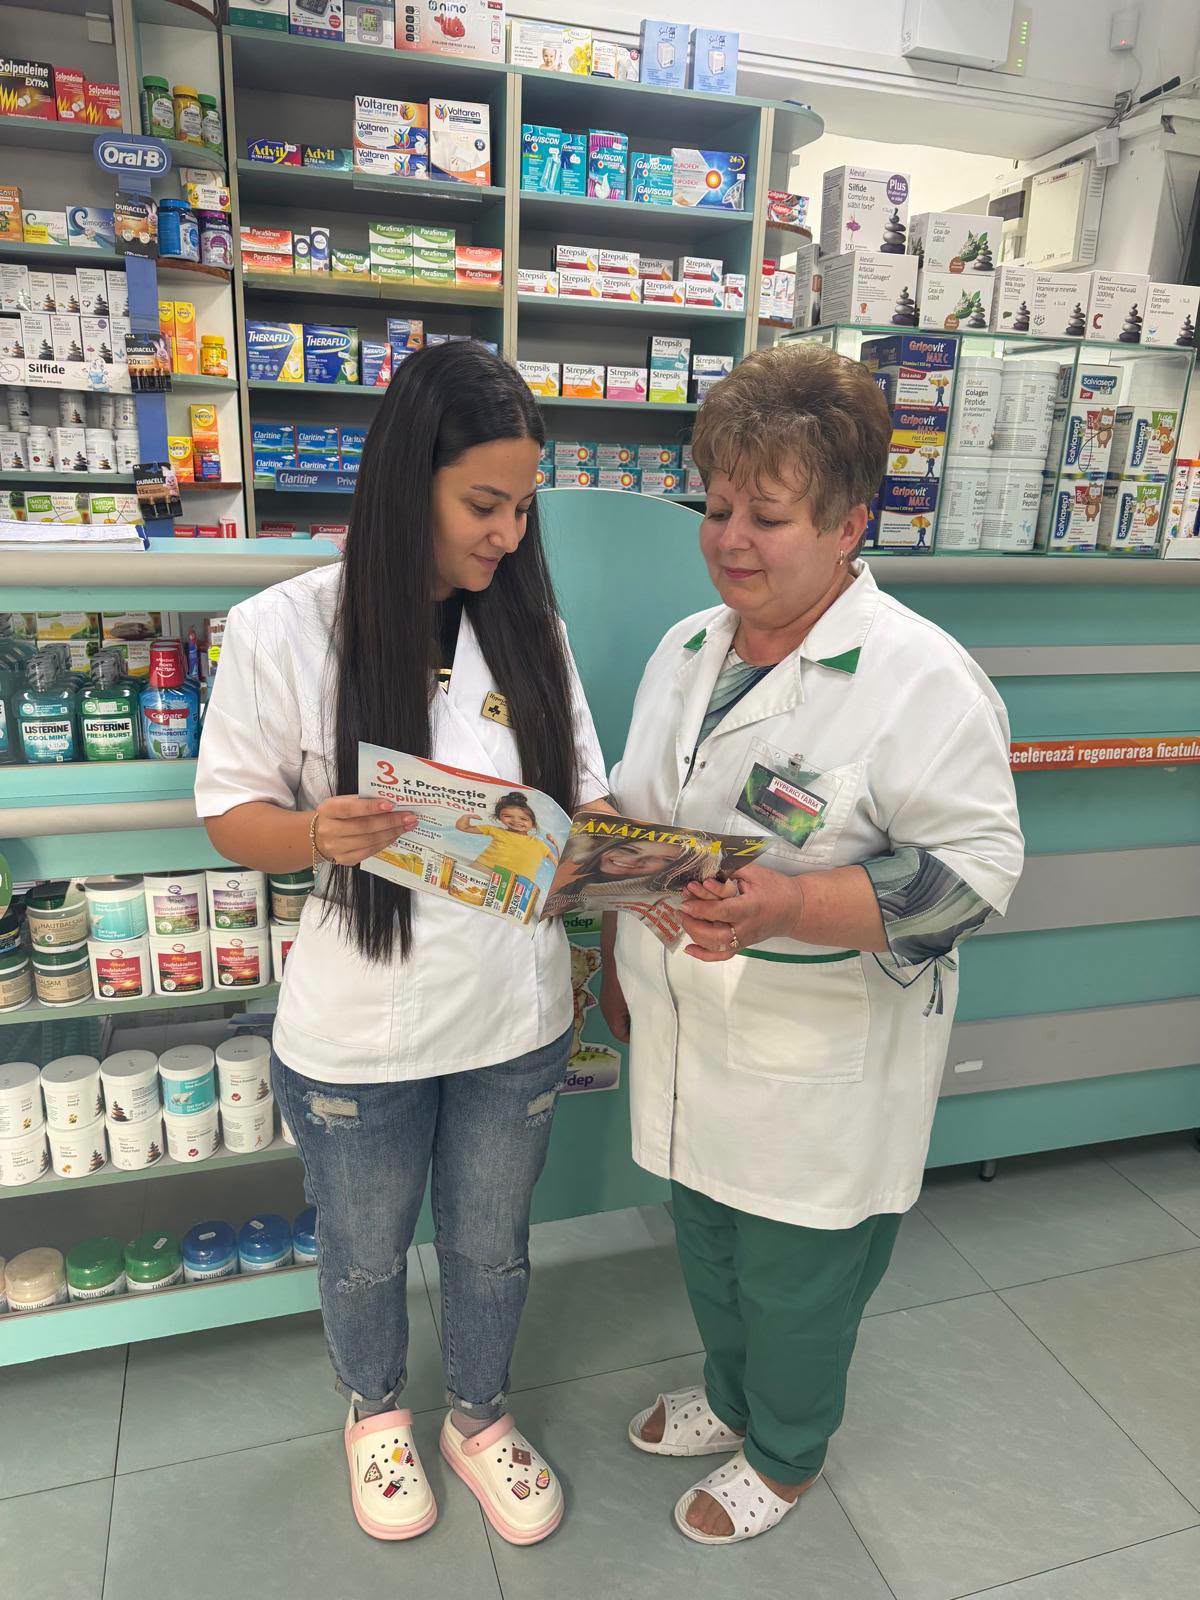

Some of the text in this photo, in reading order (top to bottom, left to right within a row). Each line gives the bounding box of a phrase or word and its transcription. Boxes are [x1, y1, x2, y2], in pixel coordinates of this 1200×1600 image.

[0, 59, 49, 79] Solpadeine
[25, 78, 49, 88] EXTRA
[357, 97, 399, 114] Voltaren
[448, 107, 480, 118] Voltaren
[357, 122, 389, 133] Voltaren
[525, 134, 560, 145] GAVISCON
[253, 145, 285, 157] Advil
[305, 148, 335, 161] Advil
[358, 149, 390, 161] Voltaren
[592, 152, 623, 163] GAVISCON
[637, 160, 672, 173] GAVISCON
[848, 183, 867, 193] Silfide
[889, 179, 906, 191] Plus
[637, 186, 672, 198] GAVISCON
[115, 203, 147, 215] DURACELL
[377, 225, 404, 235] ParaSinus
[421, 228, 448, 238] ParaSinus
[378, 246, 405, 256] ParaSinus
[421, 251, 448, 260] ParaSinus
[559, 247, 588, 259] Strepsils
[601, 251, 629, 263] Strepsils
[253, 254, 282, 264] ParaSinus
[639, 260, 663, 270] trepsils
[686, 259, 712, 270] Strepsils
[421, 270, 448, 280] ParaSinus
[465, 271, 492, 281] ParaSinus
[518, 271, 547, 283] Strepsils
[562, 274, 591, 286] Strepsils
[604, 278, 631, 290] Strepsils
[646, 281, 674, 292] Strepsils
[688, 285, 714, 296] Strepsils
[248, 330, 290, 345] THERAFLU
[306, 335, 347, 349] THERAFLU
[127, 346, 156, 356] DURACELL
[363, 347, 386, 355] THERAFLU
[654, 339, 683, 351] Strepsils
[909, 341, 946, 354] Gripovit
[695, 356, 723, 367] Strepsils
[28, 363, 66, 376] Silfide
[519, 363, 550, 376] Strepsils
[566, 366, 596, 378] Strepsils
[609, 368, 639, 380] Strepsils
[652, 371, 680, 383] Strepsils
[1083, 377, 1115, 390] Salviasept
[965, 389, 989, 399] Colagen
[900, 414, 937, 427] Gripovit
[254, 431, 281, 442] Claritine
[299, 433, 325, 444] Claritine
[255, 459, 283, 470] Claritine
[300, 461, 327, 471] Claritine
[136, 477, 164, 486] DURACELL
[279, 472, 318, 486] Claritine
[892, 486, 928, 499] Gripovit
[151, 712, 183, 722] Colgate
[24, 723, 70, 735] LISTERINE
[86, 721, 131, 735] LISTERINE
[28, 734, 68, 743] COOL MINT
[86, 731, 131, 741] FRESH BURST
[162, 743, 178, 753] 24/7
[1077, 745, 1154, 765] regenerarea
[376, 760, 488, 803] 3 x Protecție
[370, 781, 488, 813] pentru imunitatea
[377, 789, 443, 810] copilului
[773, 780, 819, 810] HYPERICI FARM
